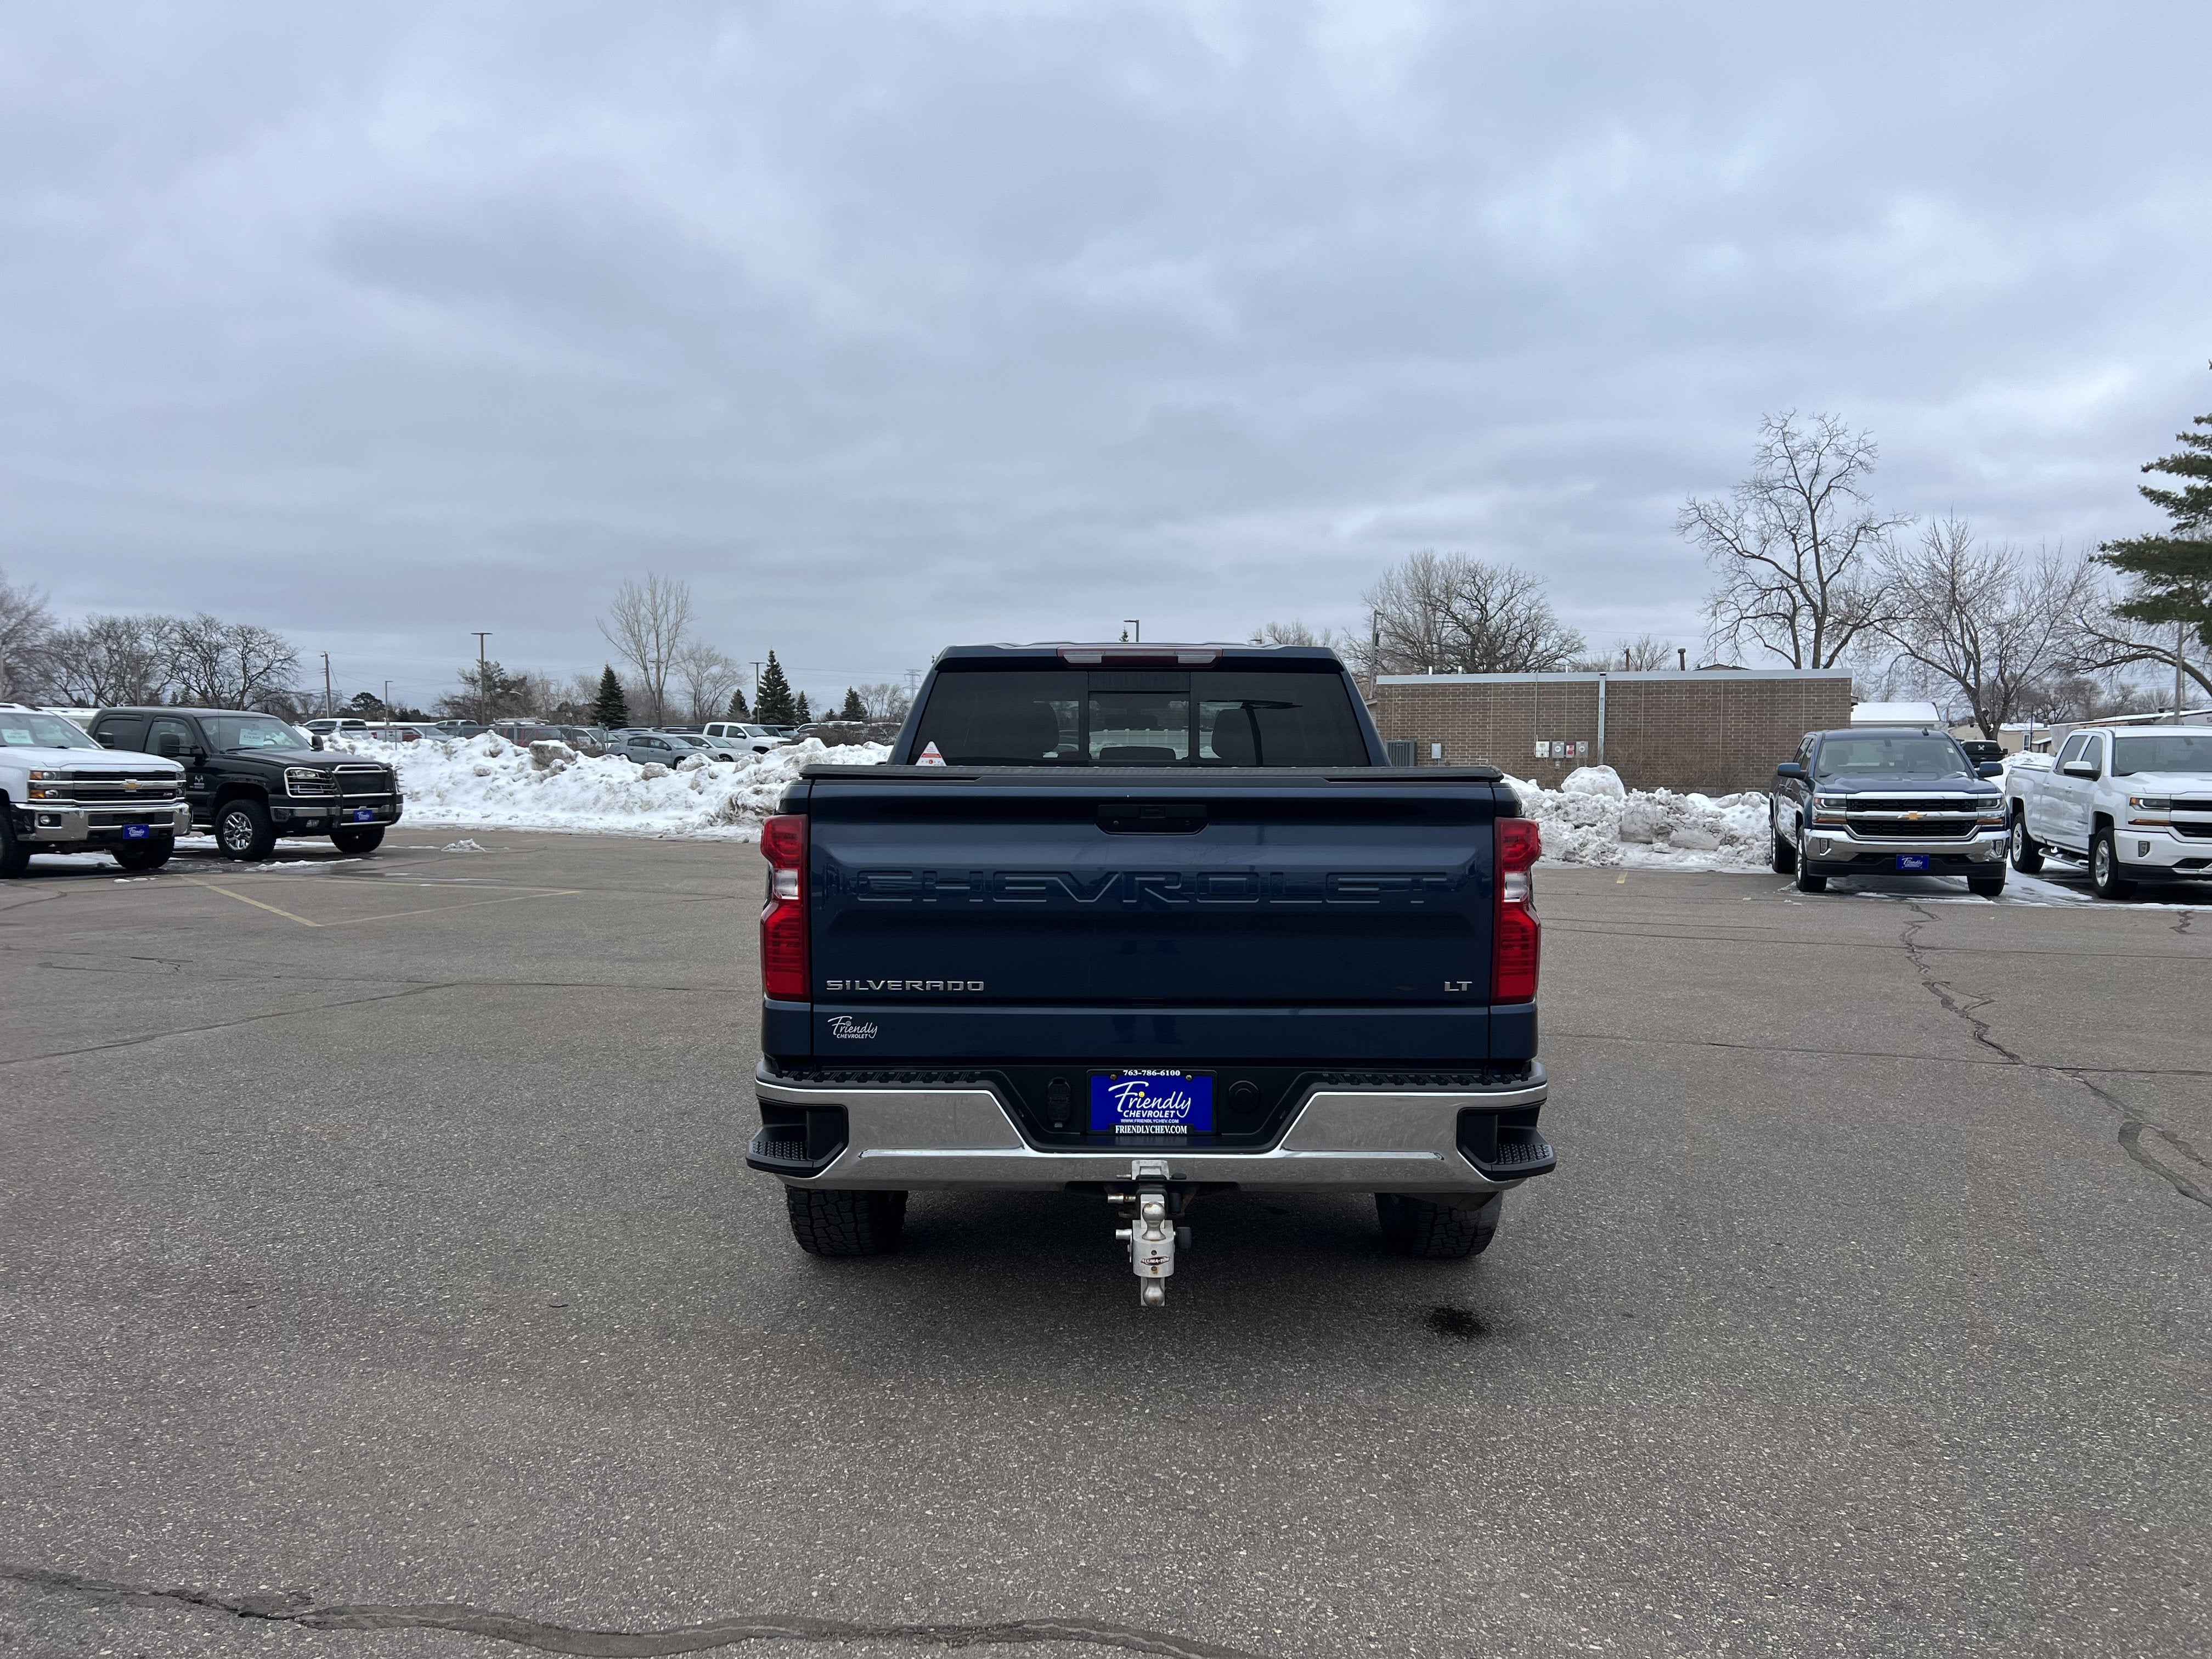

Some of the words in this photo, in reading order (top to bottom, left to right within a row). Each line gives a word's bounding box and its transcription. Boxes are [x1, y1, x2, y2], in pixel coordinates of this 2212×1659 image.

[857, 871, 1447, 904] CHEVROLET
[826, 980, 985, 991] SILVERADO
[1444, 981, 1473, 992] LT
[827, 1015, 878, 1039] Friendly
[1108, 1081, 1191, 1118] Friendly
[1123, 1110, 1176, 1118] CHEVROLET
[1115, 1125, 1187, 1134] FRIENDLYCHEV.COM
